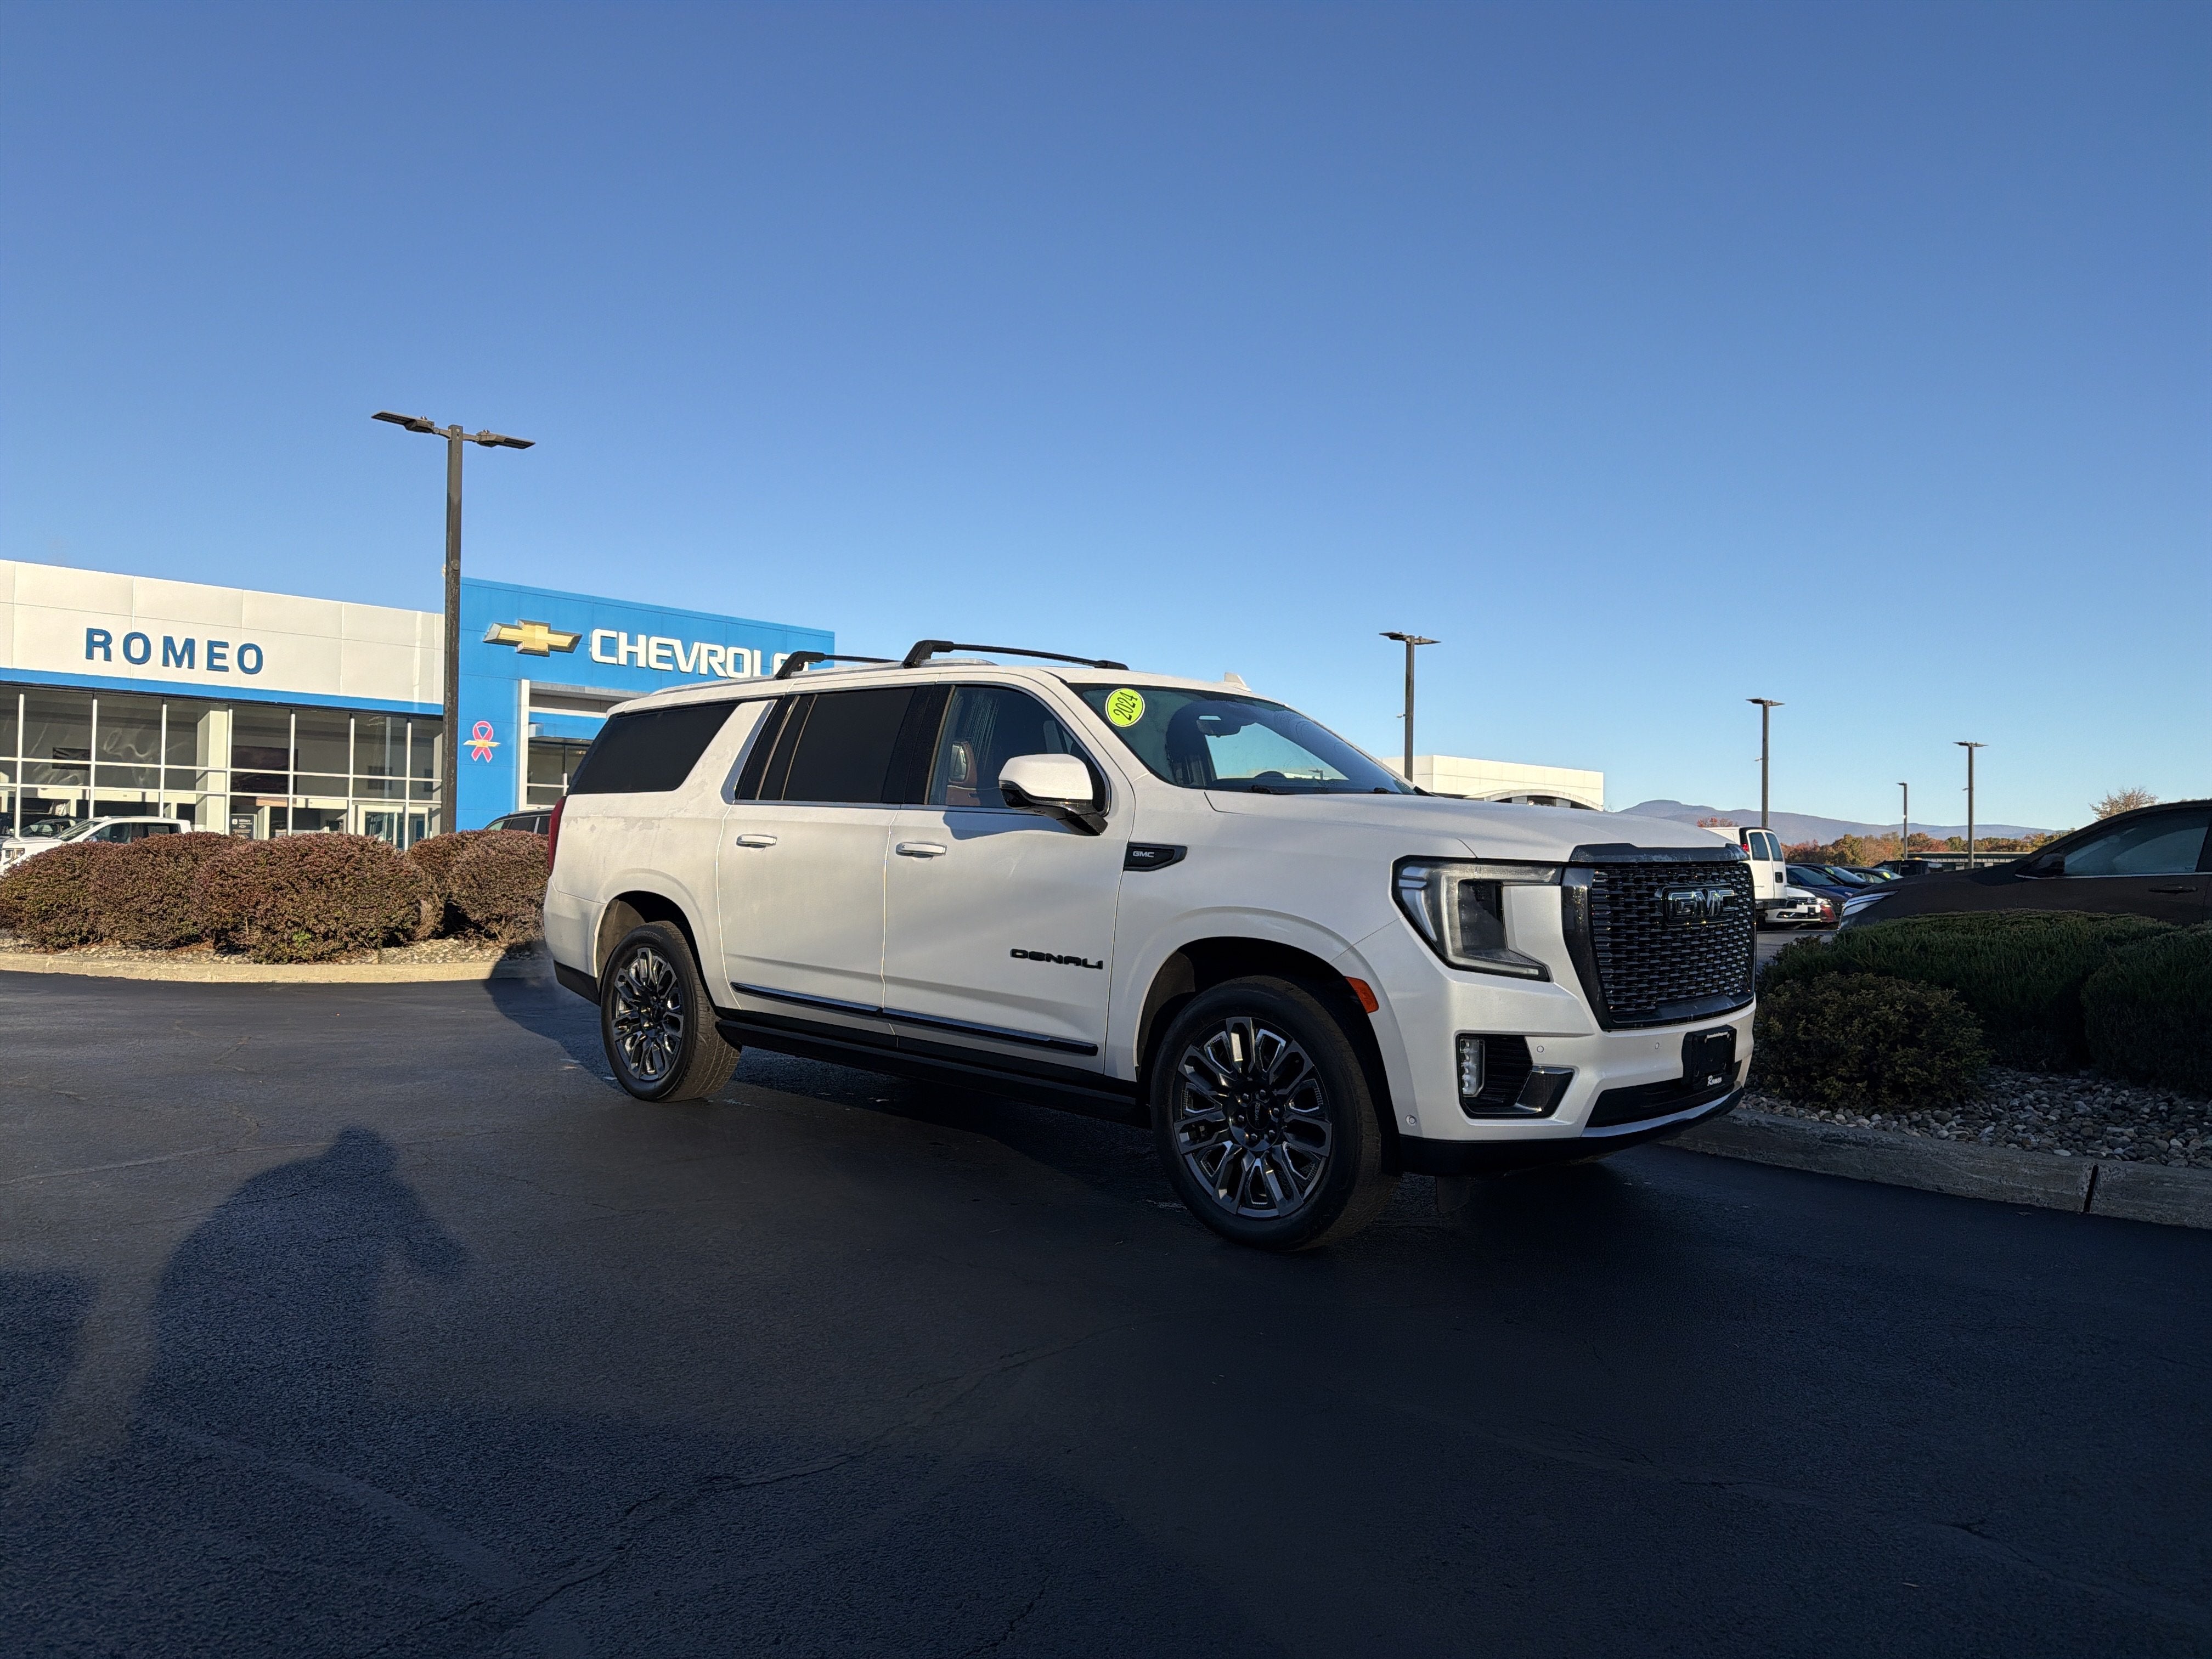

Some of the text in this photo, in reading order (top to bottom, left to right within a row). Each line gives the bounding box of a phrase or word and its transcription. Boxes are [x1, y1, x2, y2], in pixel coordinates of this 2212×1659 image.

[85, 627, 263, 675] ROMEO
[591, 629, 809, 679] CHEVROL
[1113, 691, 1138, 721] 2024
[1668, 889, 1738, 920] GMC
[1009, 948, 1103, 970] DENALI
